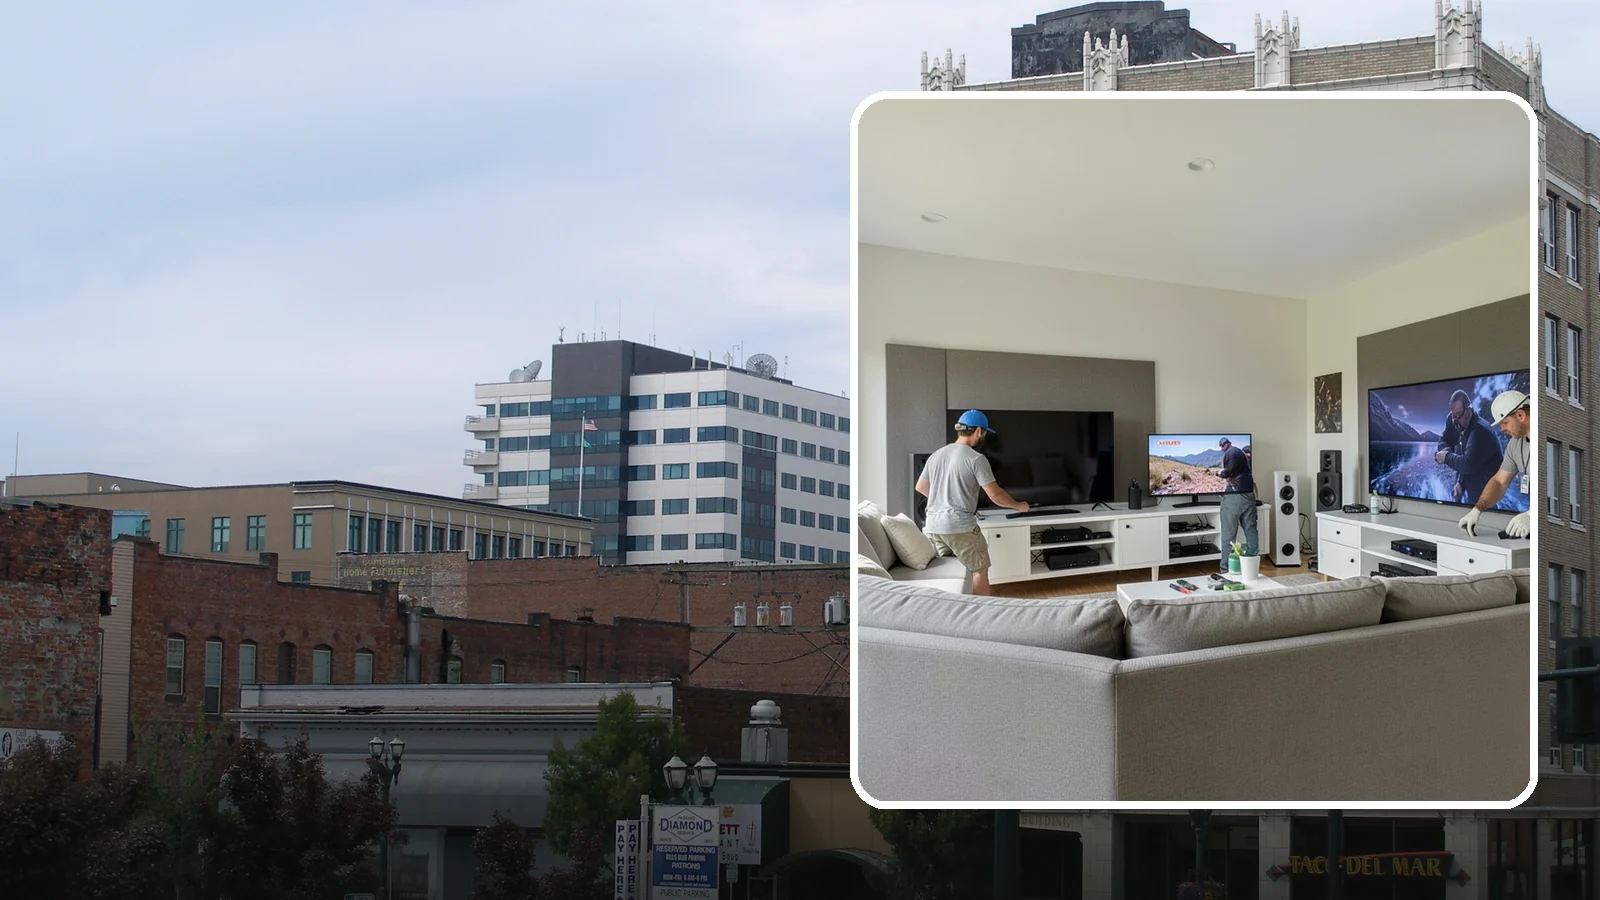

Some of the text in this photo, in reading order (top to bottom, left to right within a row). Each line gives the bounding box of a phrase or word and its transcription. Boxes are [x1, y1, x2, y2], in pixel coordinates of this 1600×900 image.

[370, 566, 427, 576] Furnishers
[660, 818, 713, 832] DIAMOND
[1020, 814, 1070, 828] BUILDING
[656, 845, 716, 854] RESERVED PARKING
[616, 825, 625, 893] PAY HERE
[627, 824, 636, 893] PAY HERE
[671, 862, 701, 870] PATRONS
[1346, 856, 1386, 875] DEL
[1392, 857, 1442, 877] MAR
[660, 889, 710, 898] PUBLIC PARKING
